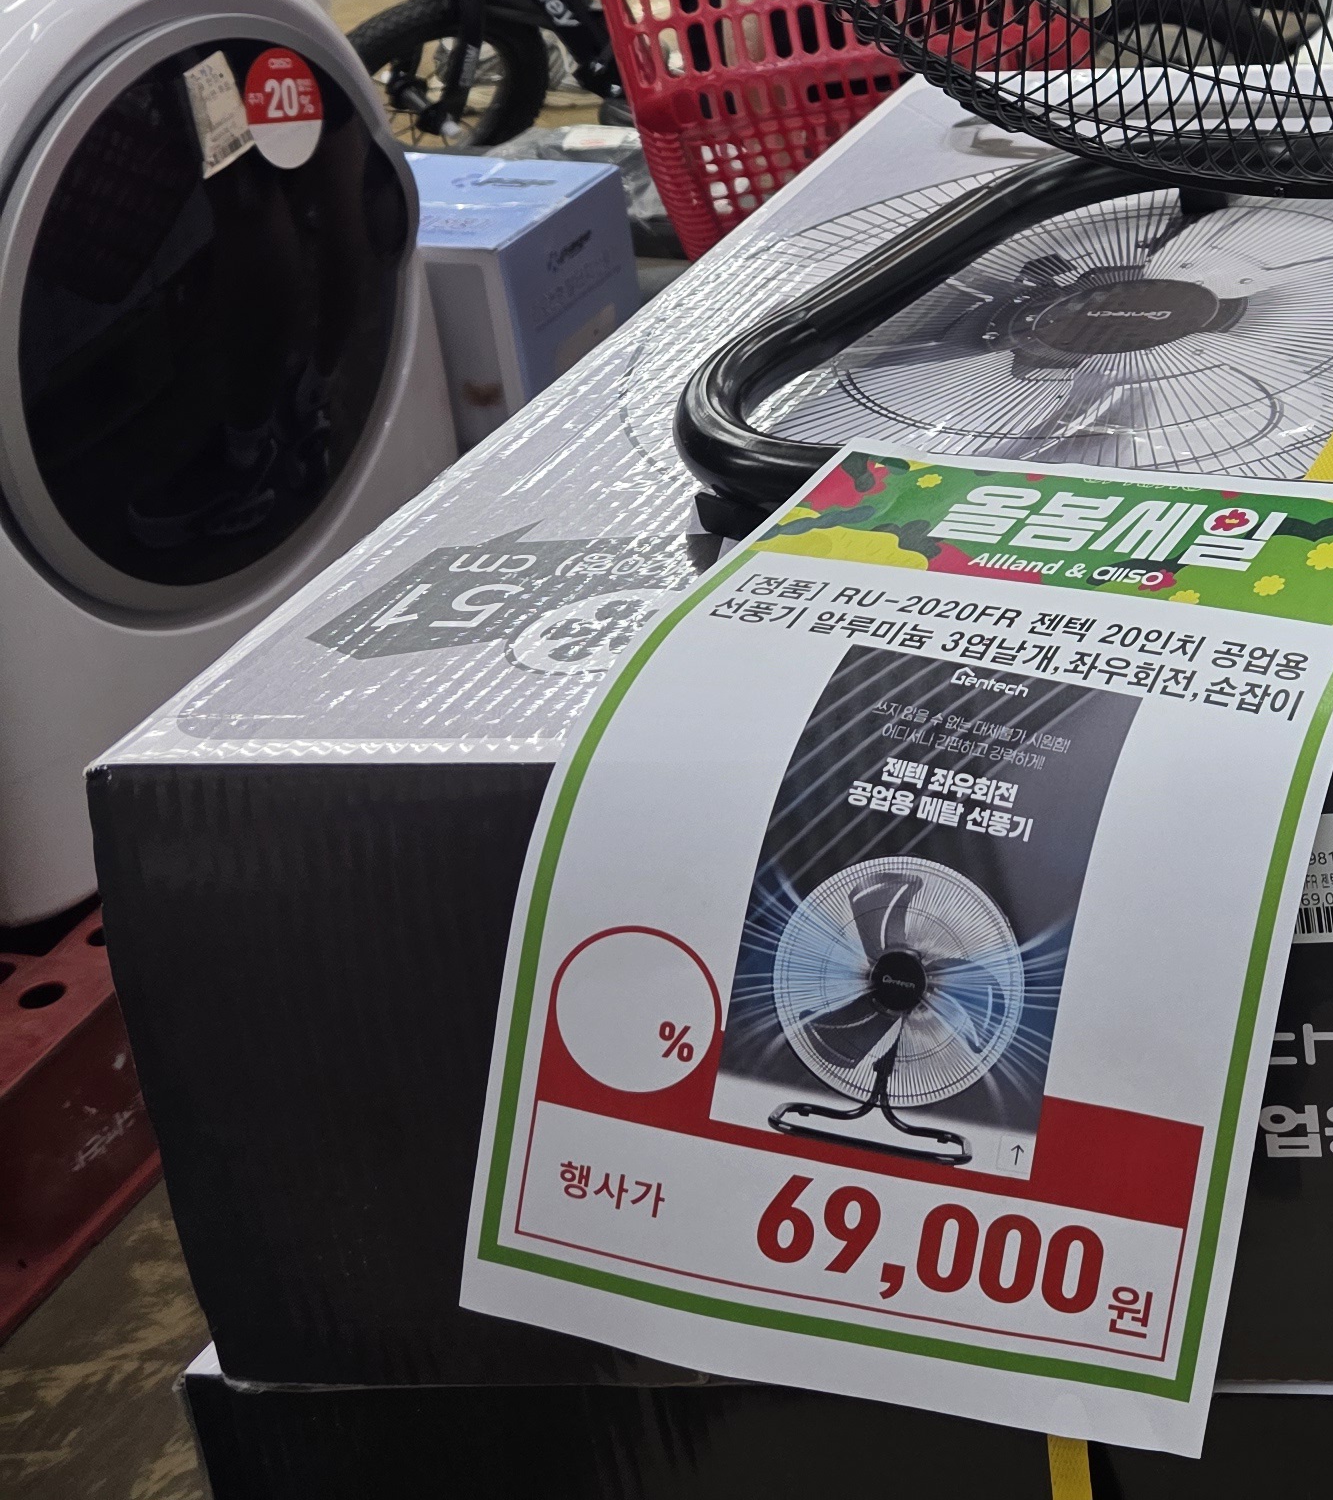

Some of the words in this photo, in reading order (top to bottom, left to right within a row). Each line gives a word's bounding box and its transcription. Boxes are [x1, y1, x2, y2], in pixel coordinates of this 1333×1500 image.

[265, 78, 299, 118] 20
[927, 484, 1288, 573] 올봄세일
[448, 554, 535, 574] cm
[967, 551, 1064, 578] Allland
[1064, 562, 1086, 579] &
[709, 597, 809, 630] 선풍기
[808, 610, 935, 651] 알루미늄
[735, 573, 831, 603] [정품]
[831, 586, 1023, 629] RU-2020FR
[1029, 611, 1093, 645] 젠텍
[1098, 624, 1206, 664] 20인치
[1212, 639, 1310, 681] 공업용
[950, 666, 1031, 699] Gentech
[872, 701, 902, 717] 쓰지
[901, 706, 930, 724] 않을
[930, 712, 944, 726] 수
[945, 715, 972, 733] 없는
[973, 720, 1028, 744] 대체불가
[882, 723, 934, 747] 어디서나
[934, 734, 988, 758] 간편하고
[881, 757, 929, 789] 젠텍
[928, 767, 1019, 808] 좌우회전
[847, 780, 915, 817] 공업용
[916, 795, 965, 827] 메탈
[965, 804, 1034, 842] 선풍기
[657, 1022, 695, 1063] %
[558, 1157, 667, 1219] 행사가
[754, 1174, 1105, 1316] 69,000
[1106, 1285, 1154, 1340] 원
